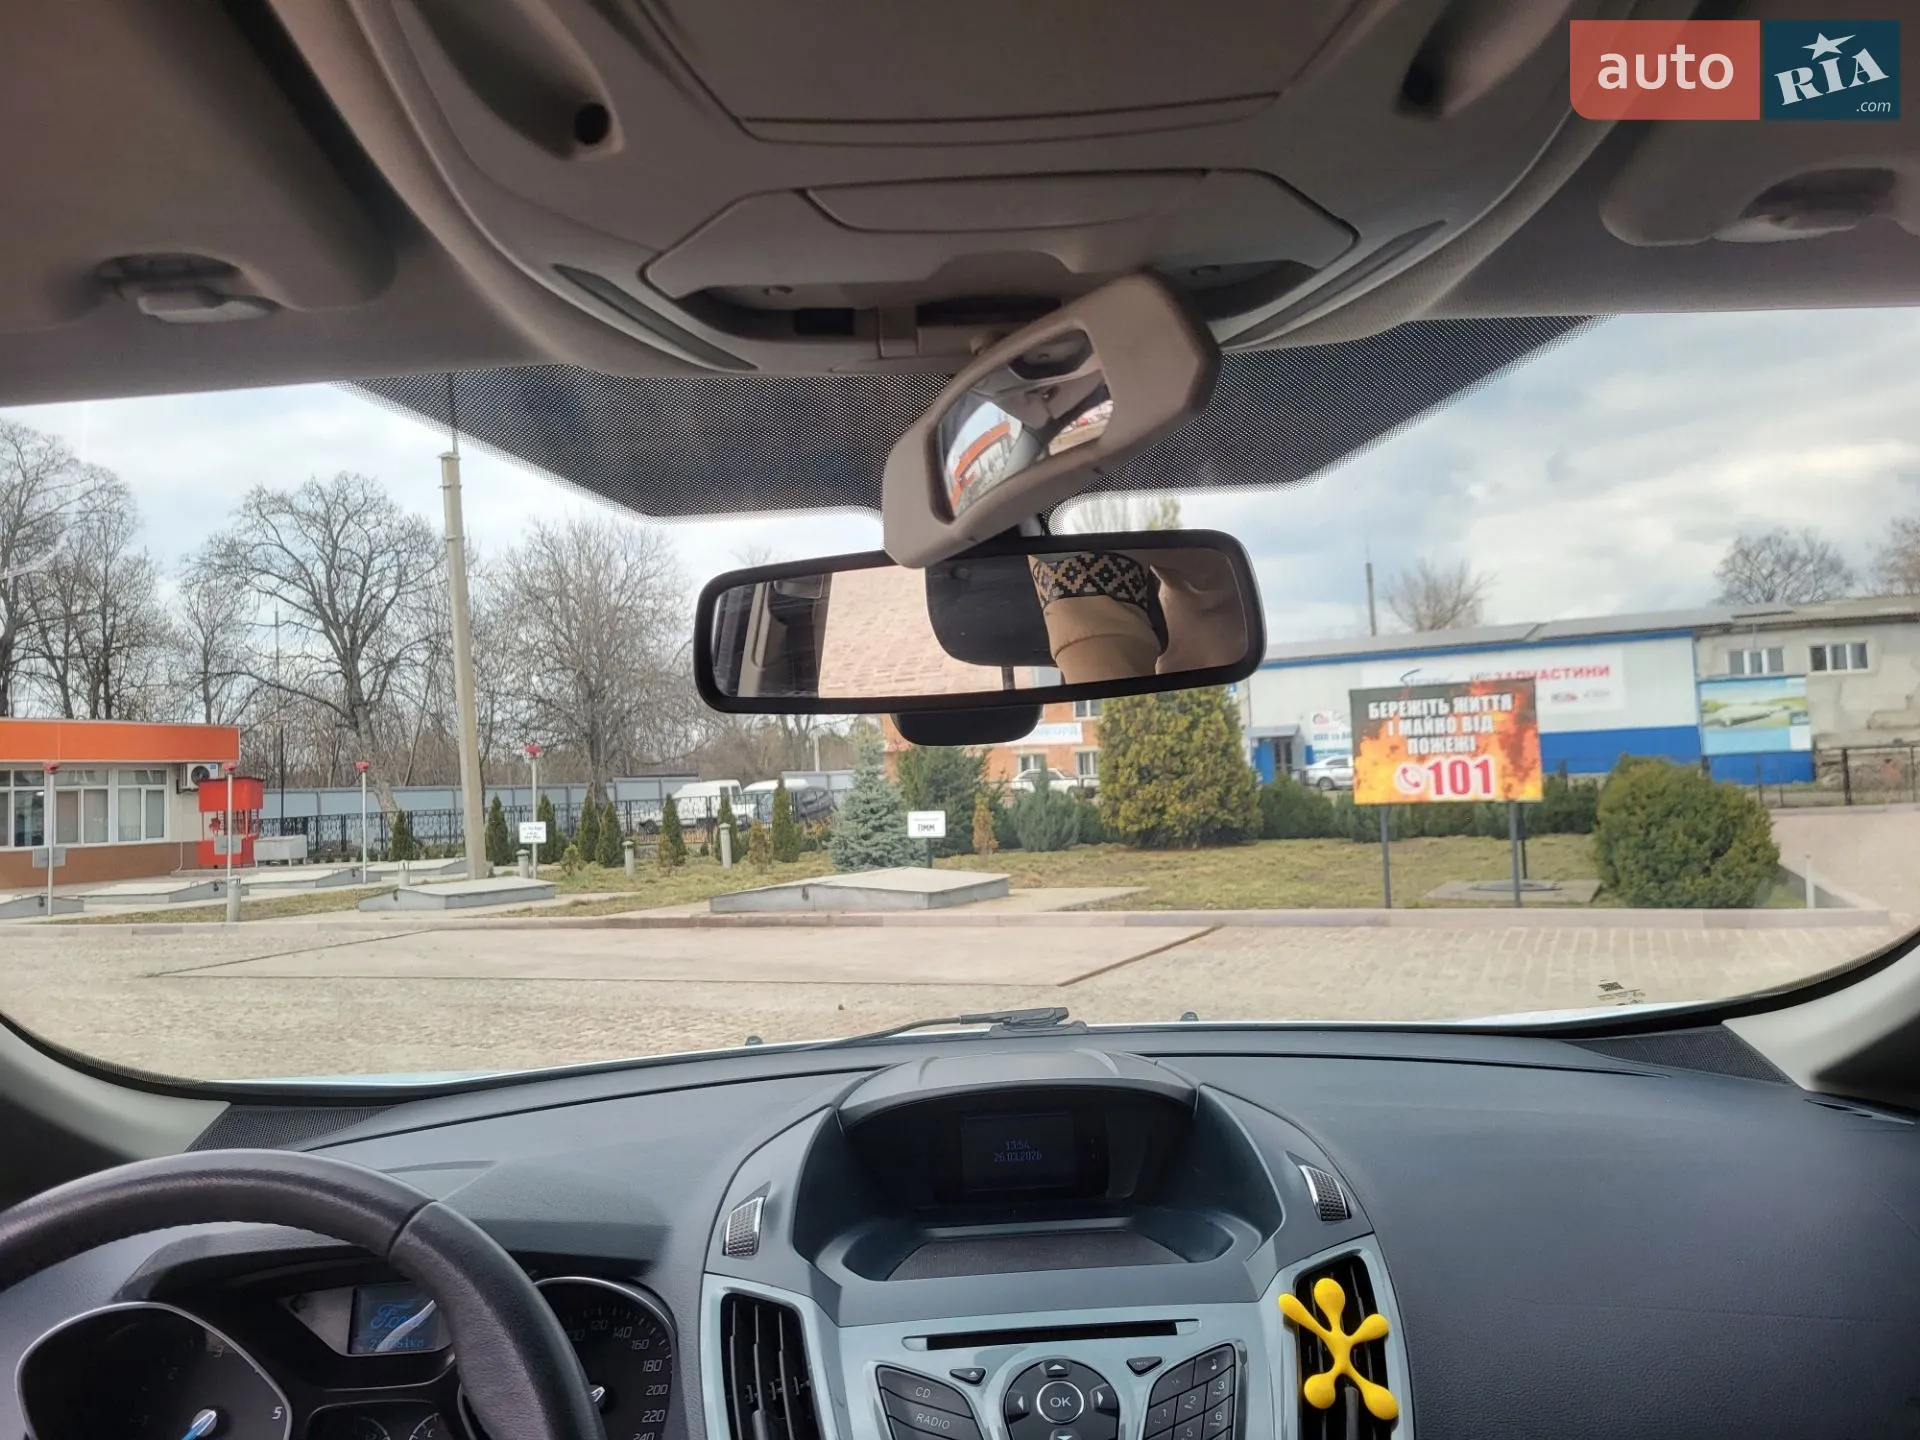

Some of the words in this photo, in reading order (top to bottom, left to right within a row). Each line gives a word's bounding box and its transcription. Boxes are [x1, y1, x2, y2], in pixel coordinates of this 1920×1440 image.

[1367, 697, 1450, 720] БЕРЕЖІТЬ
[1452, 693, 1514, 713] ЖИТТЯ
[1387, 720, 1395, 736] І
[1461, 715, 1494, 734] ВІД
[1407, 735, 1477, 755] ПОЖЕЖІ
[1427, 759, 1492, 796] 101
[612, 1326, 633, 1339] 140
[631, 1339, 650, 1351] 160
[642, 1359, 663, 1373] 180
[646, 1384, 669, 1396] 200
[1218, 1380, 1225, 1390] 3
[915, 1386, 931, 1399] CD
[1050, 1396, 1072, 1407] OK
[1190, 1395, 1197, 1406] 2
[271, 1406, 283, 1420] 5
[641, 1410, 666, 1423] 220
[1162, 1408, 1167, 1418] 1
[1215, 1411, 1222, 1421] 6
[916, 1413, 950, 1430] RADIO
[1186, 1427, 1193, 1437] 5
